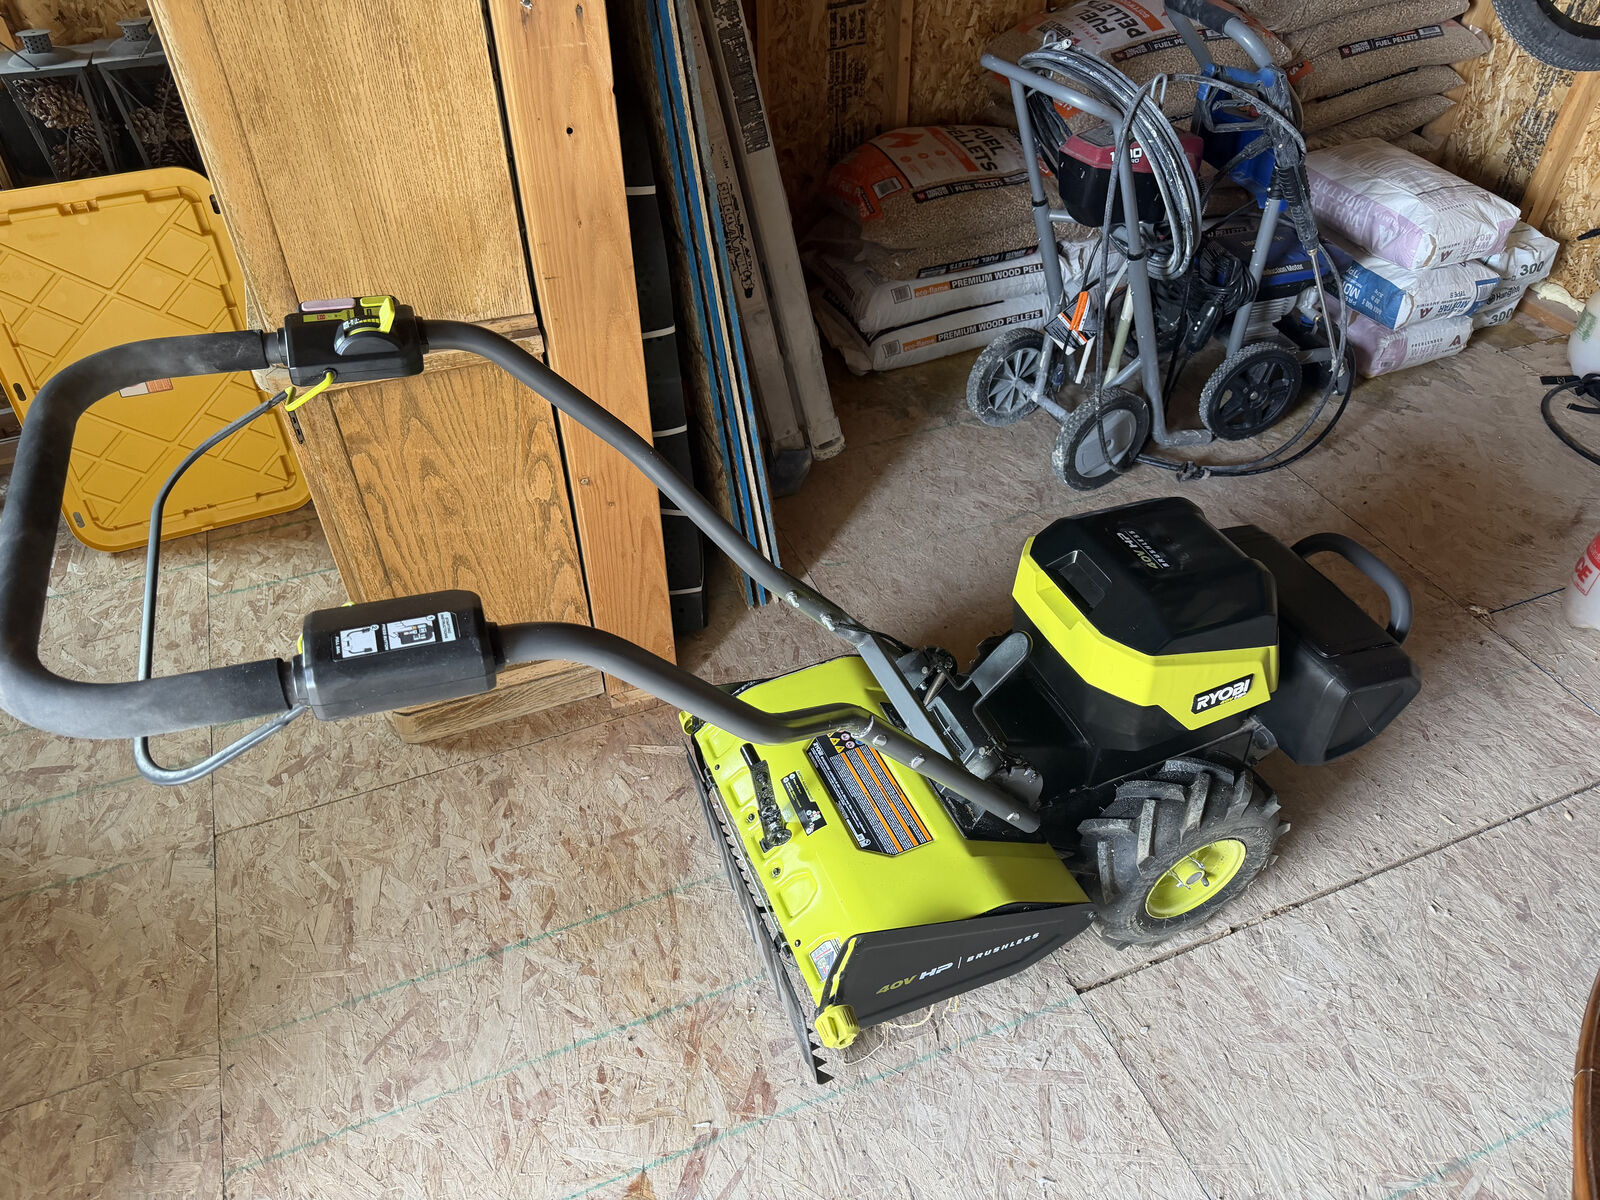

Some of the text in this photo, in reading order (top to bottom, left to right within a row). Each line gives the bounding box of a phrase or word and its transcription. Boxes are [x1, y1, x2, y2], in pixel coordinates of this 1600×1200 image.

[1075, 8, 1117, 35] FUEL
[1153, 41, 1172, 50] FUEL
[1375, 33, 1418, 48] FUEL PELLETS
[969, 127, 1004, 156] FUEL
[955, 181, 1003, 192] FUEL PELLETS
[914, 263, 1044, 298] eco-flame PREMIUM WOOD PELL
[1286, 263, 1304, 271] Motor
[1519, 260, 1544, 277] 300
[938, 325, 978, 342] PREMIUM
[978, 319, 1005, 331] WOOD
[1006, 310, 1041, 324] PELLETS
[1488, 307, 1514, 325] 300
[1116, 532, 1159, 569] 40V HP
[1128, 530, 1170, 568] BRUSHLESS
[1196, 678, 1251, 711] RYOBI
[875, 931, 1041, 996] 40V HP BRUSHLESS
